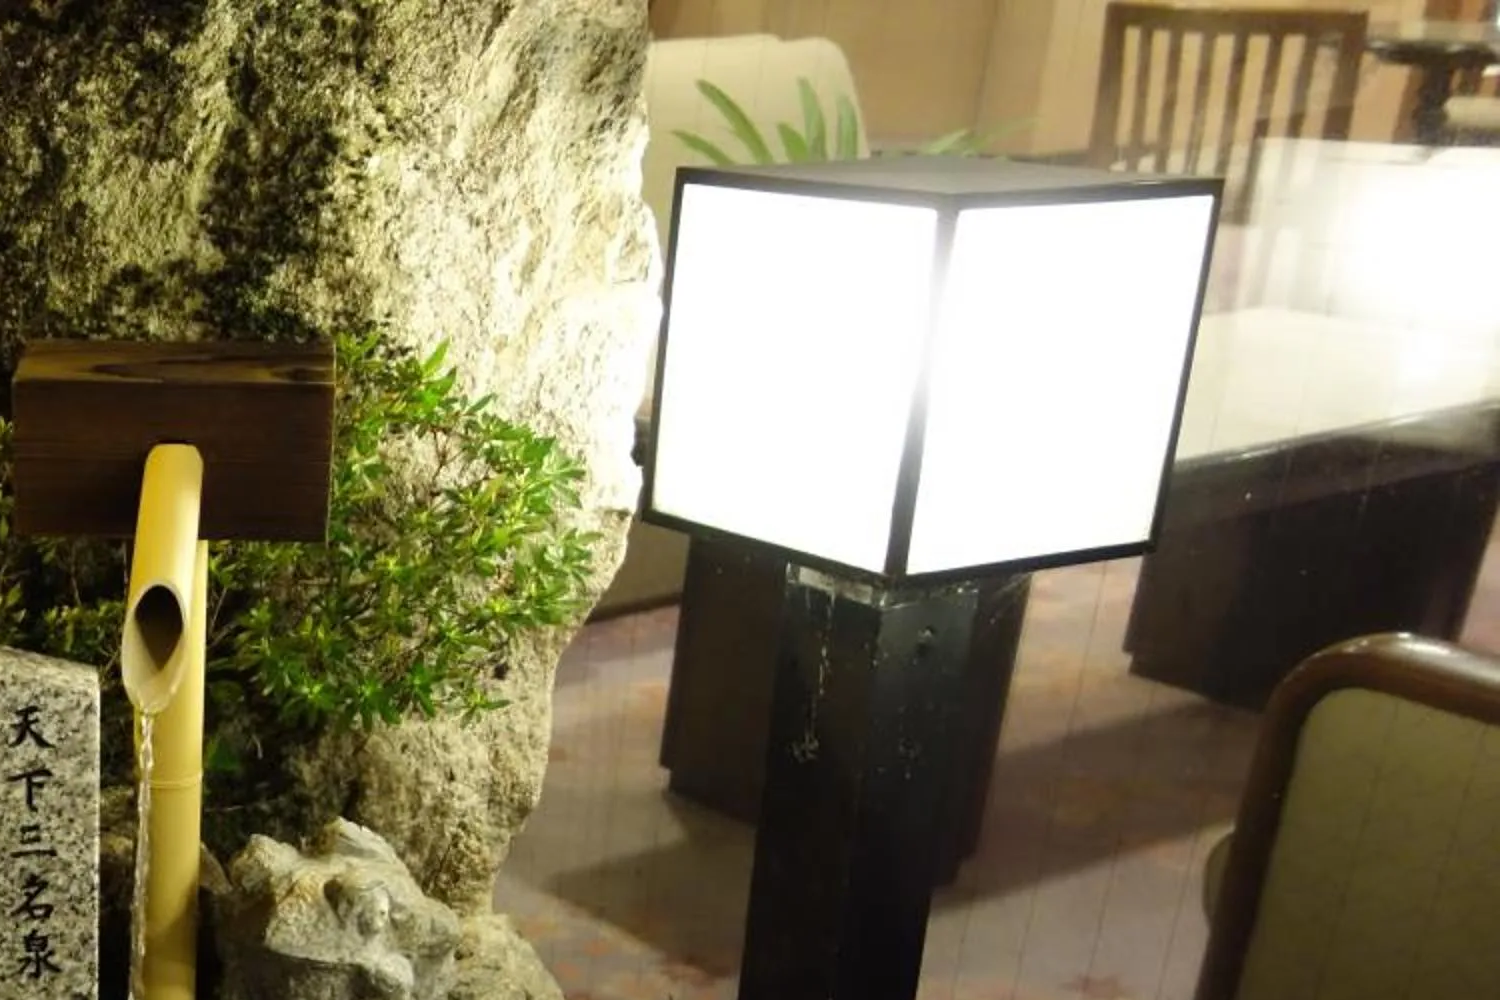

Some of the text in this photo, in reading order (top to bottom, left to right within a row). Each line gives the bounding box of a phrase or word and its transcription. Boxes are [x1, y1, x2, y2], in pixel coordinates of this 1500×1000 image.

[7, 705, 62, 979] 天下三名泉
